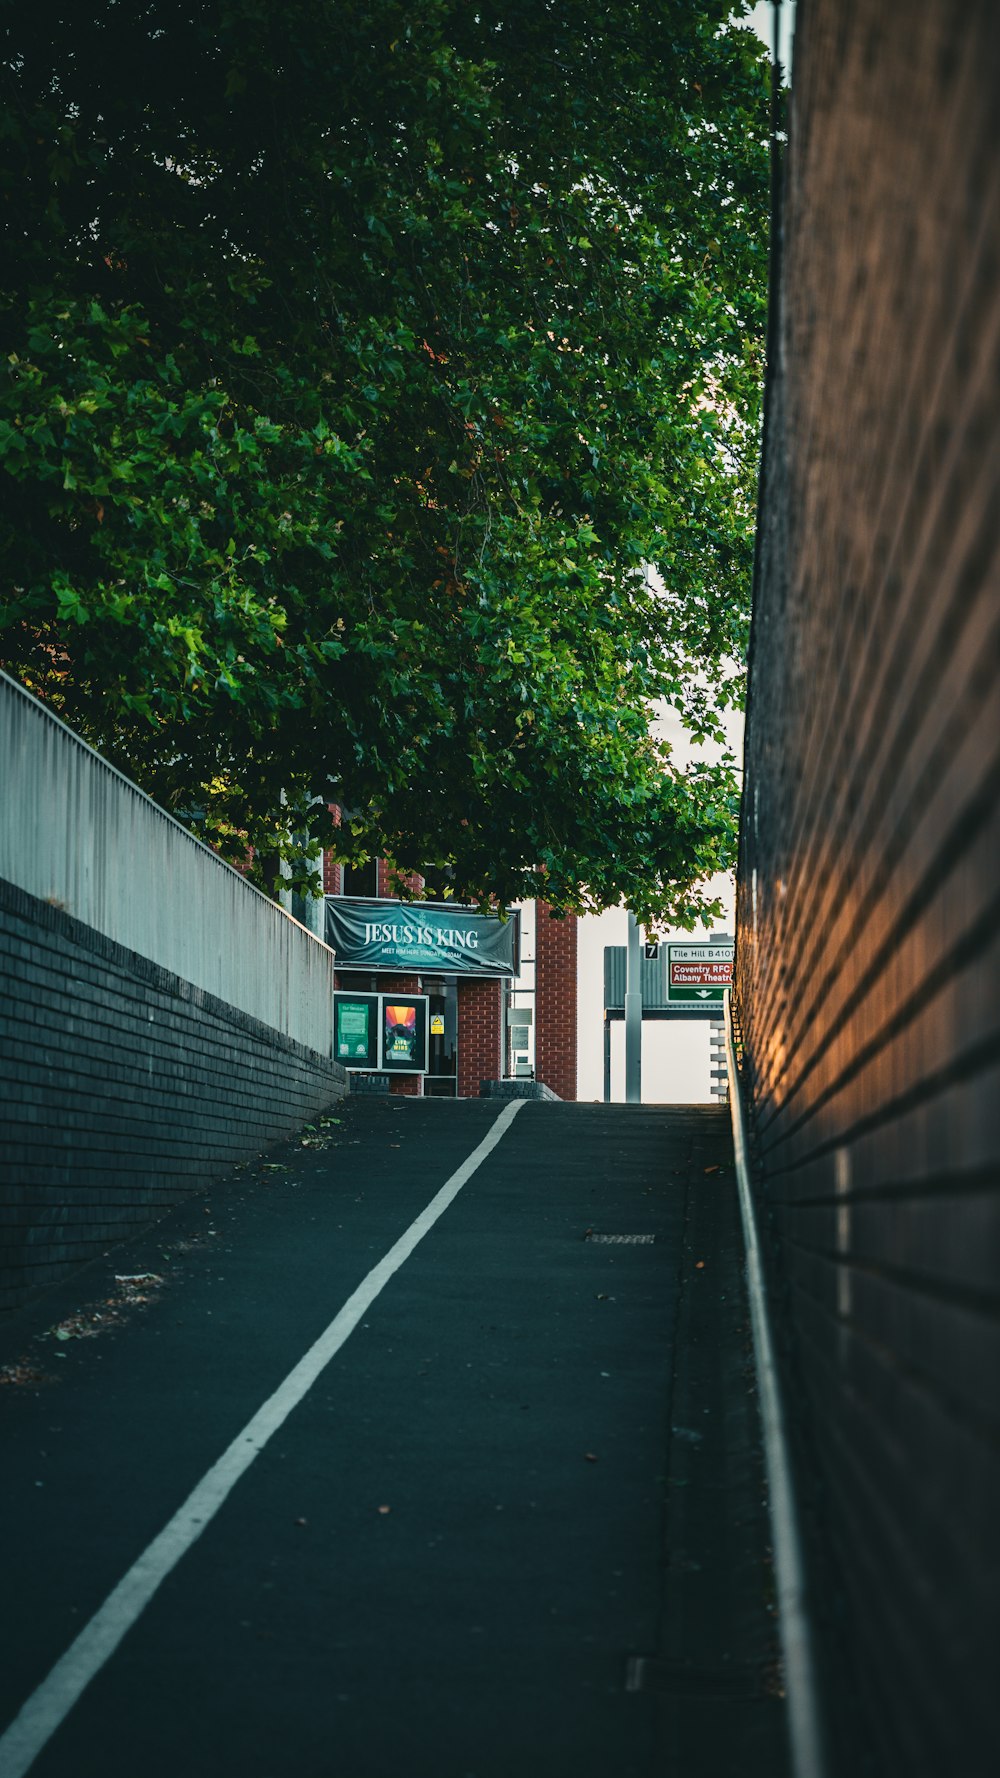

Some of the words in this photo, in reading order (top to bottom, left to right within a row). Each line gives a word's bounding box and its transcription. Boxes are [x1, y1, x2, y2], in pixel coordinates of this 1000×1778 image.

[363, 923, 413, 945] JESUS
[417, 927, 433, 946] IS
[436, 928, 478, 949] KING
[381, 947, 395, 955] MEET
[647, 945, 656, 957] 7
[673, 950, 688, 958] Tile
[691, 950, 705, 958] Hill
[674, 964, 710, 974] Coventry
[712, 964, 730, 973] RFC
[674, 974, 701, 983] Albany
